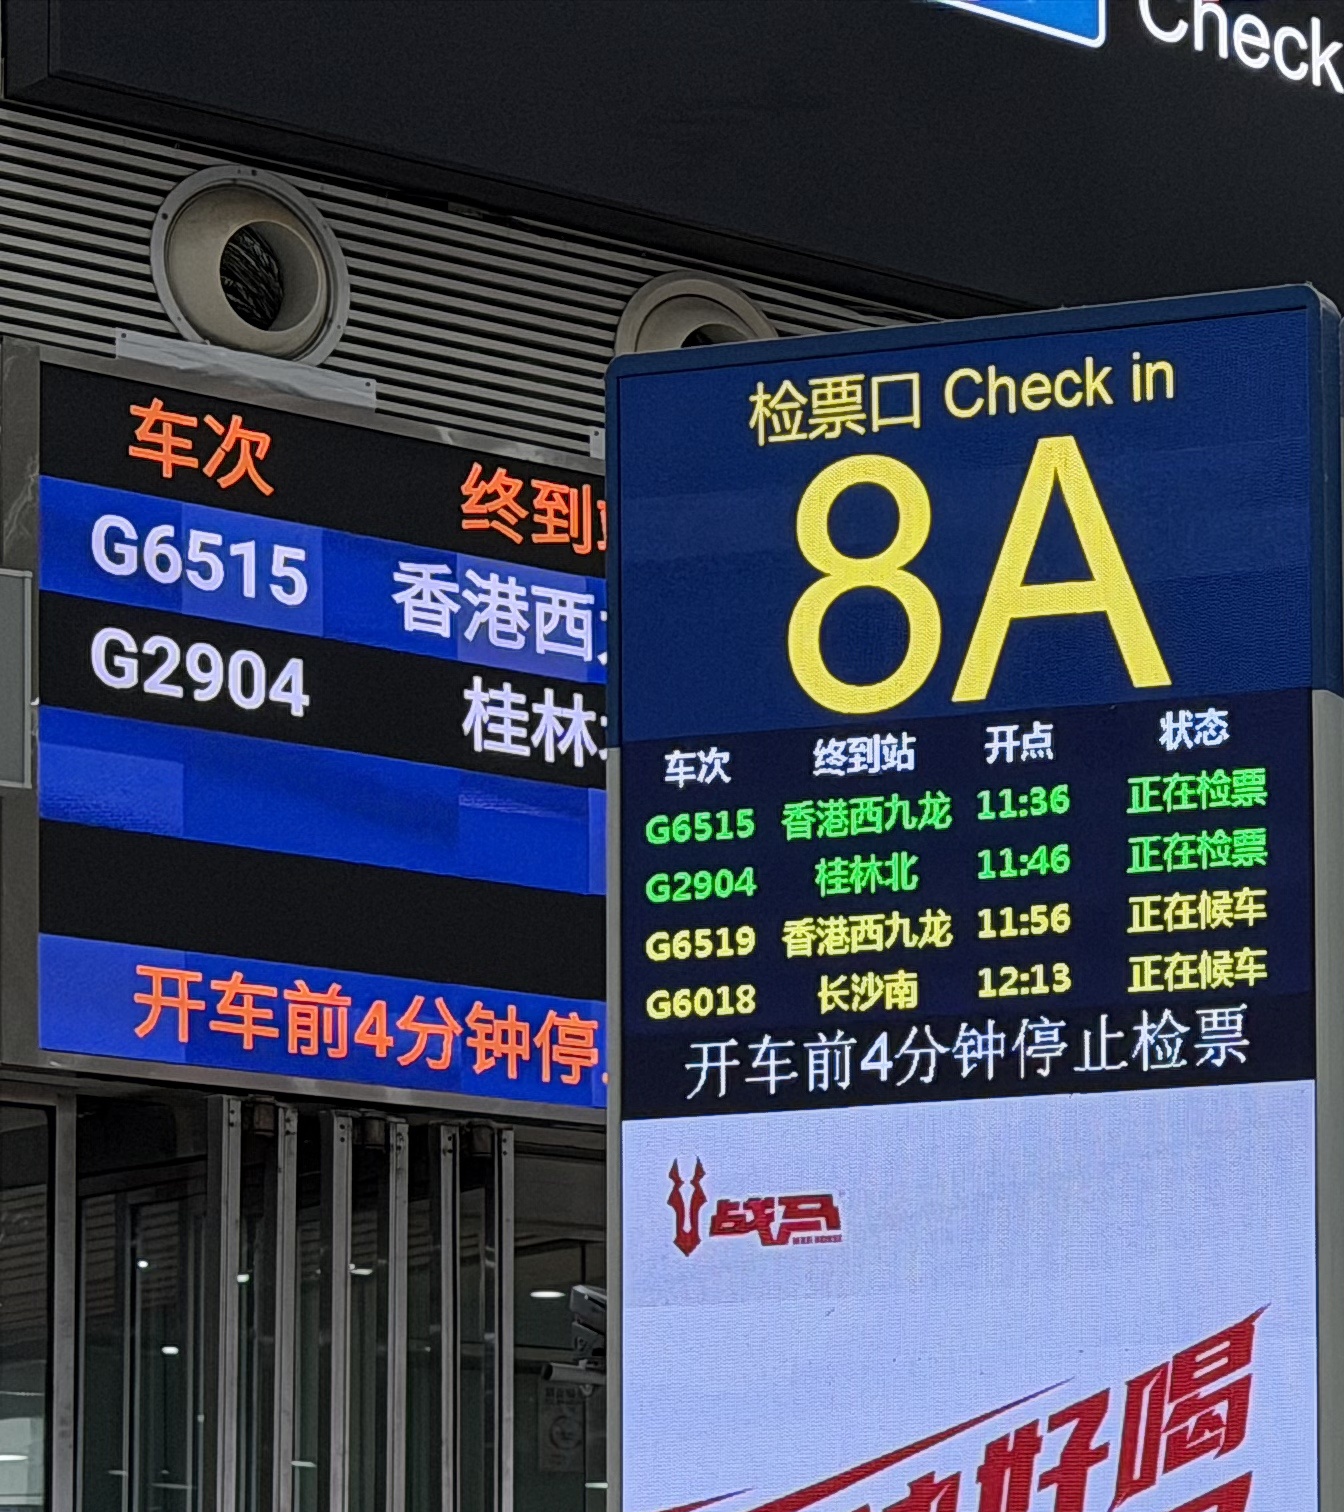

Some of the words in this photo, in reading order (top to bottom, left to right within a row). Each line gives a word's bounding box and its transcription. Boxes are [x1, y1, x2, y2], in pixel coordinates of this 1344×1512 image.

[1139, 0, 1344, 94] Check
[749, 371, 921, 447] 检票口
[944, 357, 1114, 419] Check
[1131, 352, 1175, 402] in
[129, 398, 275, 496] 车次
[460, 462, 608, 555] 终到
[91, 514, 308, 606] G6515
[392, 561, 608, 665] 香港西
[787, 435, 1172, 714] 8A
[91, 627, 310, 717] G2904
[461, 675, 608, 767] 桂林
[663, 746, 732, 787] 车次
[812, 733, 917, 777] 终到站
[984, 721, 1055, 765] 开点
[1158, 708, 1230, 750] 状态
[645, 808, 756, 845] G6515
[781, 791, 953, 842] 香港西九龙
[976, 784, 1071, 821] 11:36
[1126, 768, 1268, 817] 正在检票
[645, 867, 757, 903] G2904
[814, 850, 919, 898] 桂林北
[976, 843, 1071, 880] 11:46
[1126, 828, 1268, 876] 正在检票
[645, 925, 756, 962] G6519
[782, 908, 954, 960] 香港西九龙
[976, 903, 1072, 939] 11:56
[1127, 887, 1268, 934] 正在候车
[133, 964, 609, 1086] 开车前4分钟停
[646, 983, 757, 1020] G6018
[816, 970, 919, 1014] 长沙南
[977, 963, 1072, 999] 12:13
[1127, 948, 1268, 994] 正在候车
[685, 1004, 1251, 1100] 开车前4分钟停止检票
